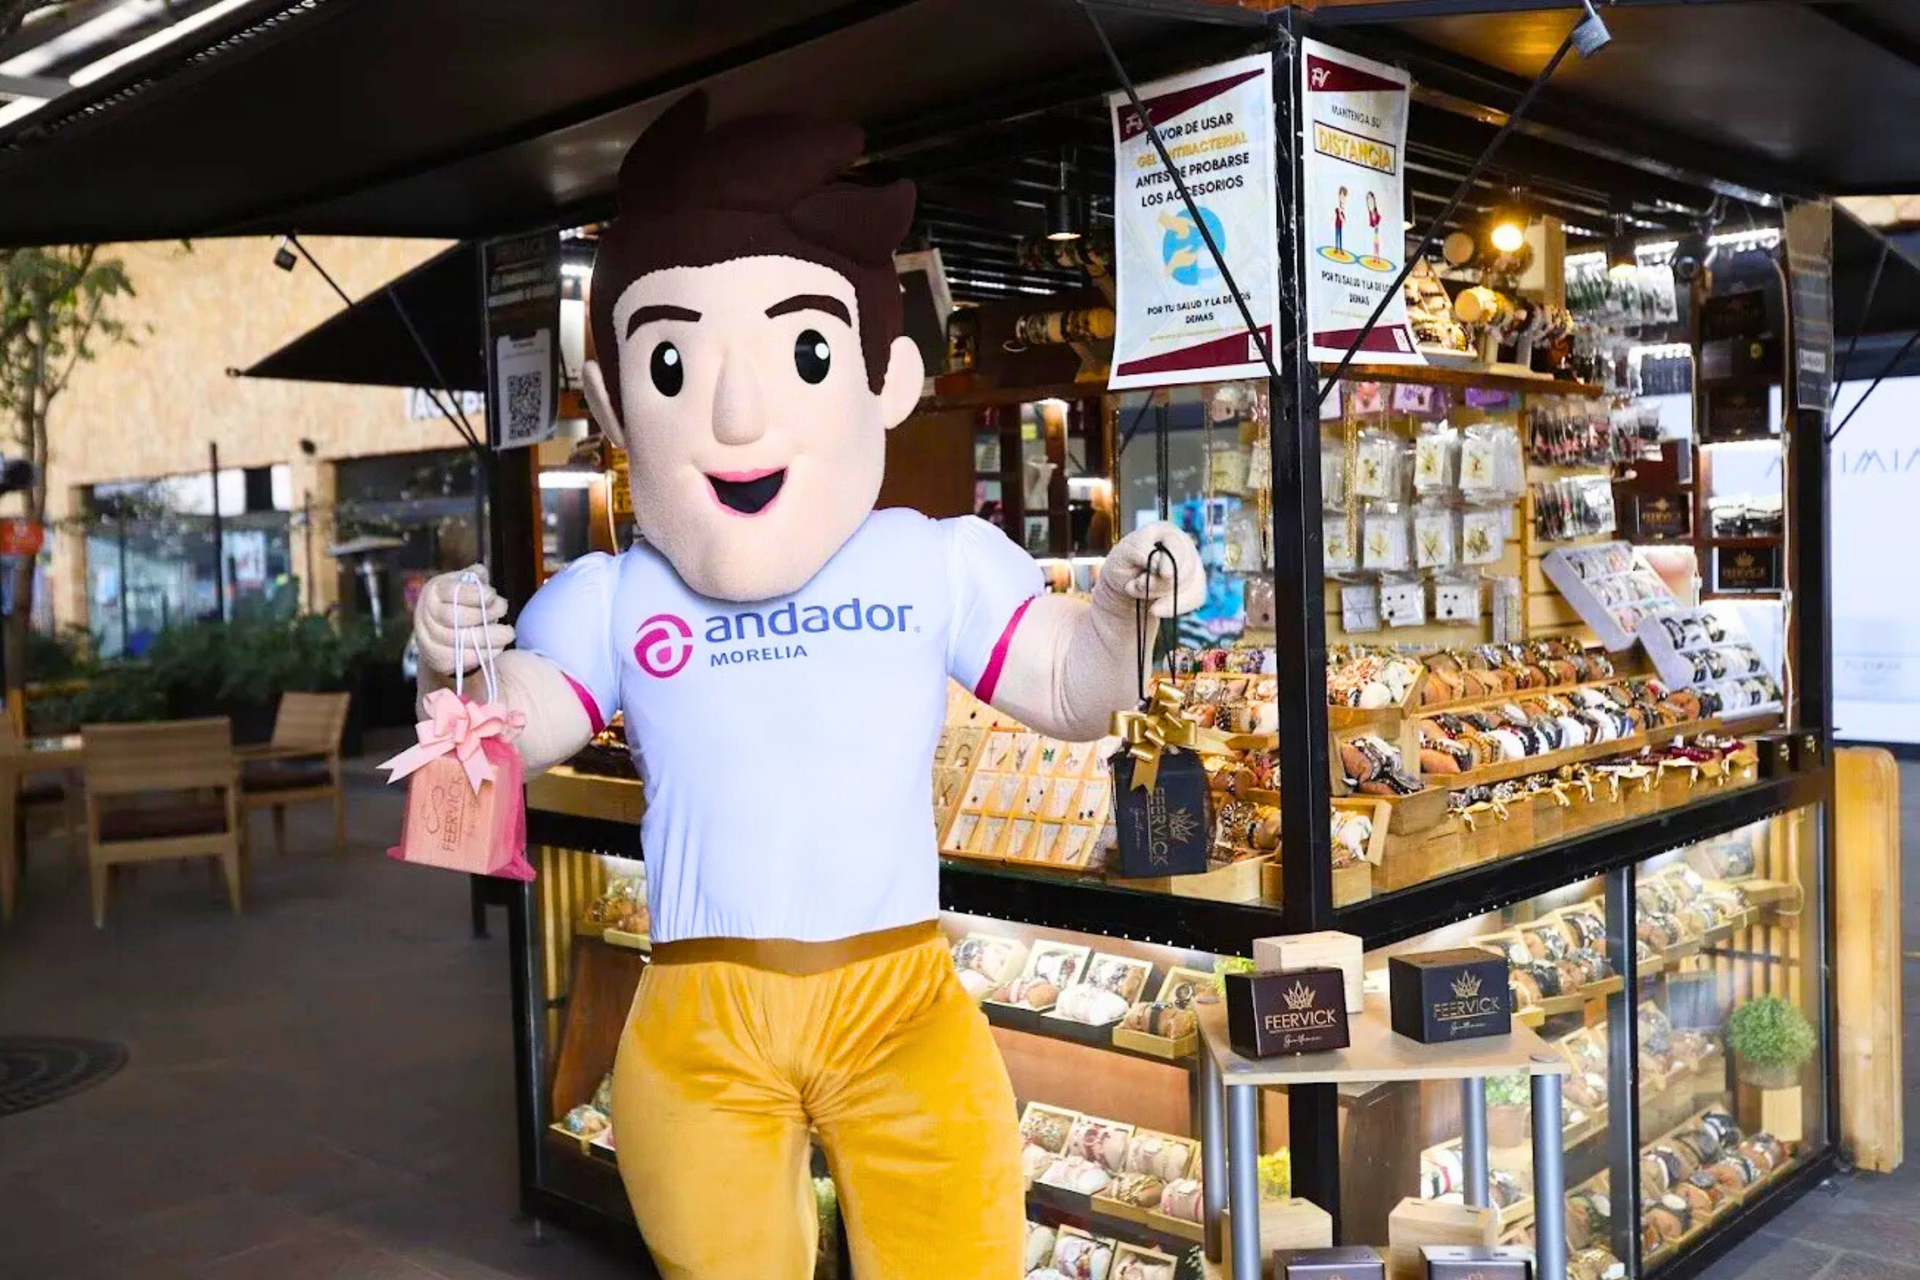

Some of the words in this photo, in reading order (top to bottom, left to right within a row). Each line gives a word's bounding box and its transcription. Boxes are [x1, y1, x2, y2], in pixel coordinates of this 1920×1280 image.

[1146, 127, 1183, 145] FVOR
[1185, 121, 1199, 135] DE
[1201, 112, 1234, 131] USAR
[1138, 153, 1157, 167] GEL
[1165, 131, 1249, 160] NTIBACTERIAL
[1318, 127, 1391, 171] DISTANCIA
[1136, 170, 1170, 188] ANTES
[1189, 152, 1249, 176] PROBARSE
[1142, 192, 1163, 207] LOS
[1147, 306, 1163, 316] POR
[1165, 304, 1175, 312] TU
[1176, 300, 1202, 312] SALUD
[1211, 296, 1221, 306] LA
[1223, 294, 1233, 304] DE
[1185, 312, 1214, 324] DEMAS
[704, 597, 914, 644] andador
[709, 644, 809, 668] MORELIA
[443, 776, 465, 852] FEERVICK
[1150, 786, 1169, 867] FEERVICK
[1265, 1008, 1337, 1030] FEERVICK
[1434, 996, 1501, 1019] FEERVICK
